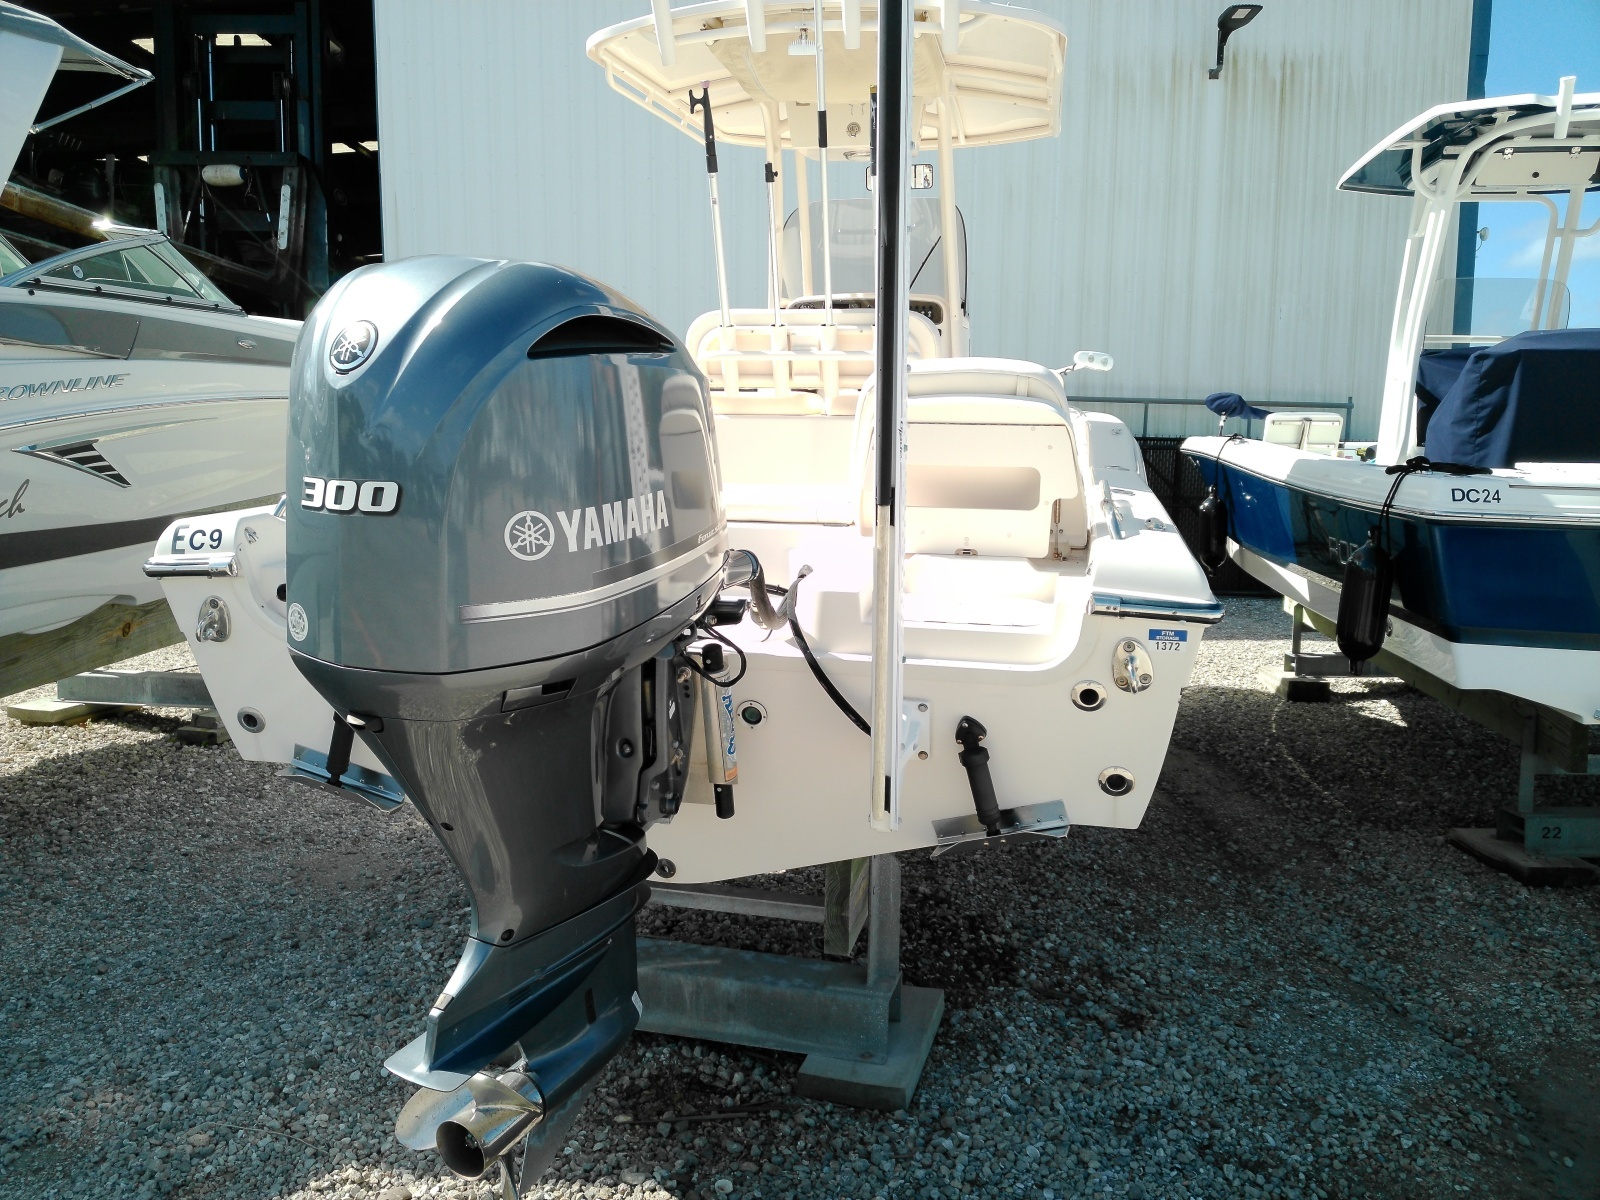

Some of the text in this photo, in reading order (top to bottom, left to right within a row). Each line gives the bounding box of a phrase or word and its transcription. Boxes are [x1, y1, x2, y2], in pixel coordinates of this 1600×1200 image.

[301, 476, 399, 513] 300
[1451, 488, 1501, 504] DC24
[556, 490, 669, 552] YAMAHA
[171, 524, 223, 554] EC9
[1155, 641, 1181, 651] 1372
[1541, 826, 1562, 839] 22
